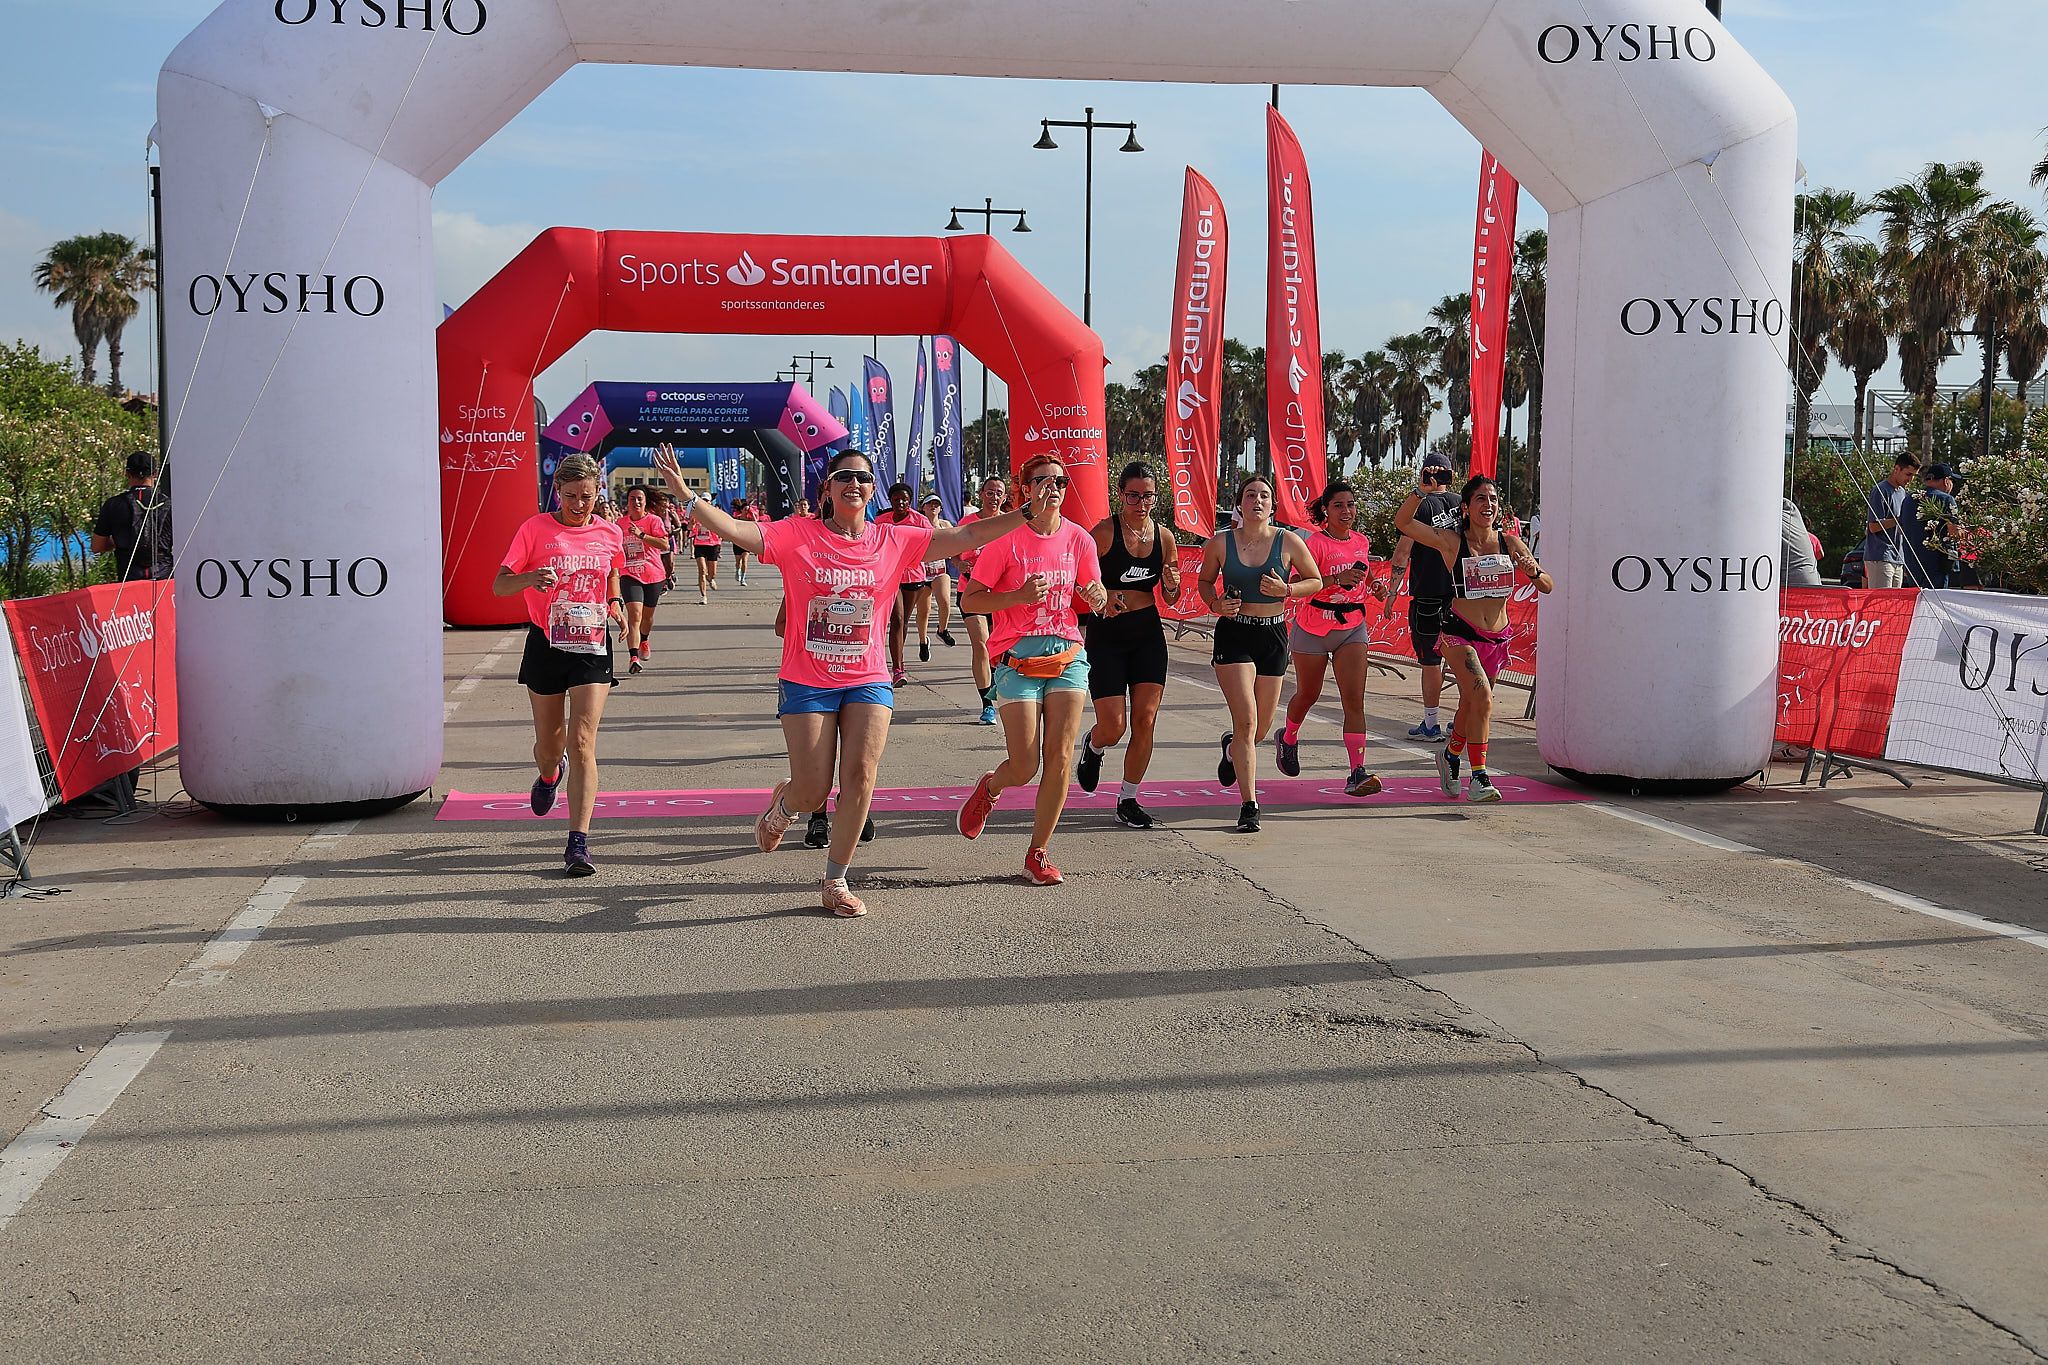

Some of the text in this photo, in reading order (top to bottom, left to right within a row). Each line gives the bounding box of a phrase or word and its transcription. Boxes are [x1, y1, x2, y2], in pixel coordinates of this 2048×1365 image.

[274, 0, 487, 36] OYSHO
[1537, 23, 1717, 64] OYSHO
[619, 254, 933, 292] Sports Santander
[189, 272, 385, 316] OYSHO
[721, 298, 825, 311] sportssantander.es
[1620, 297, 1784, 336] OYSHO
[661, 391, 744, 404] octopus energy
[459, 404, 506, 422] Sports
[652, 405, 688, 414] ENERGÍA
[714, 407, 748, 415] CORRER
[1044, 403, 1088, 420] Sports
[456, 429, 526, 443] Santander
[1041, 427, 1103, 440] Santander
[550, 553, 602, 571] CARRERA
[195, 556, 389, 599] OYSHO
[815, 567, 876, 587] CARRERA
[1127, 566, 1150, 577] NIKE
[1480, 574, 1499, 582] 016
[1611, 555, 1773, 592] OYSHO
[569, 626, 592, 635] 016
[828, 623, 853, 634] 016
[1779, 609, 1881, 648] antander
[30, 604, 154, 682] Sports Santander
[813, 644, 833, 652] OYSHO
[828, 663, 846, 673] 2026
